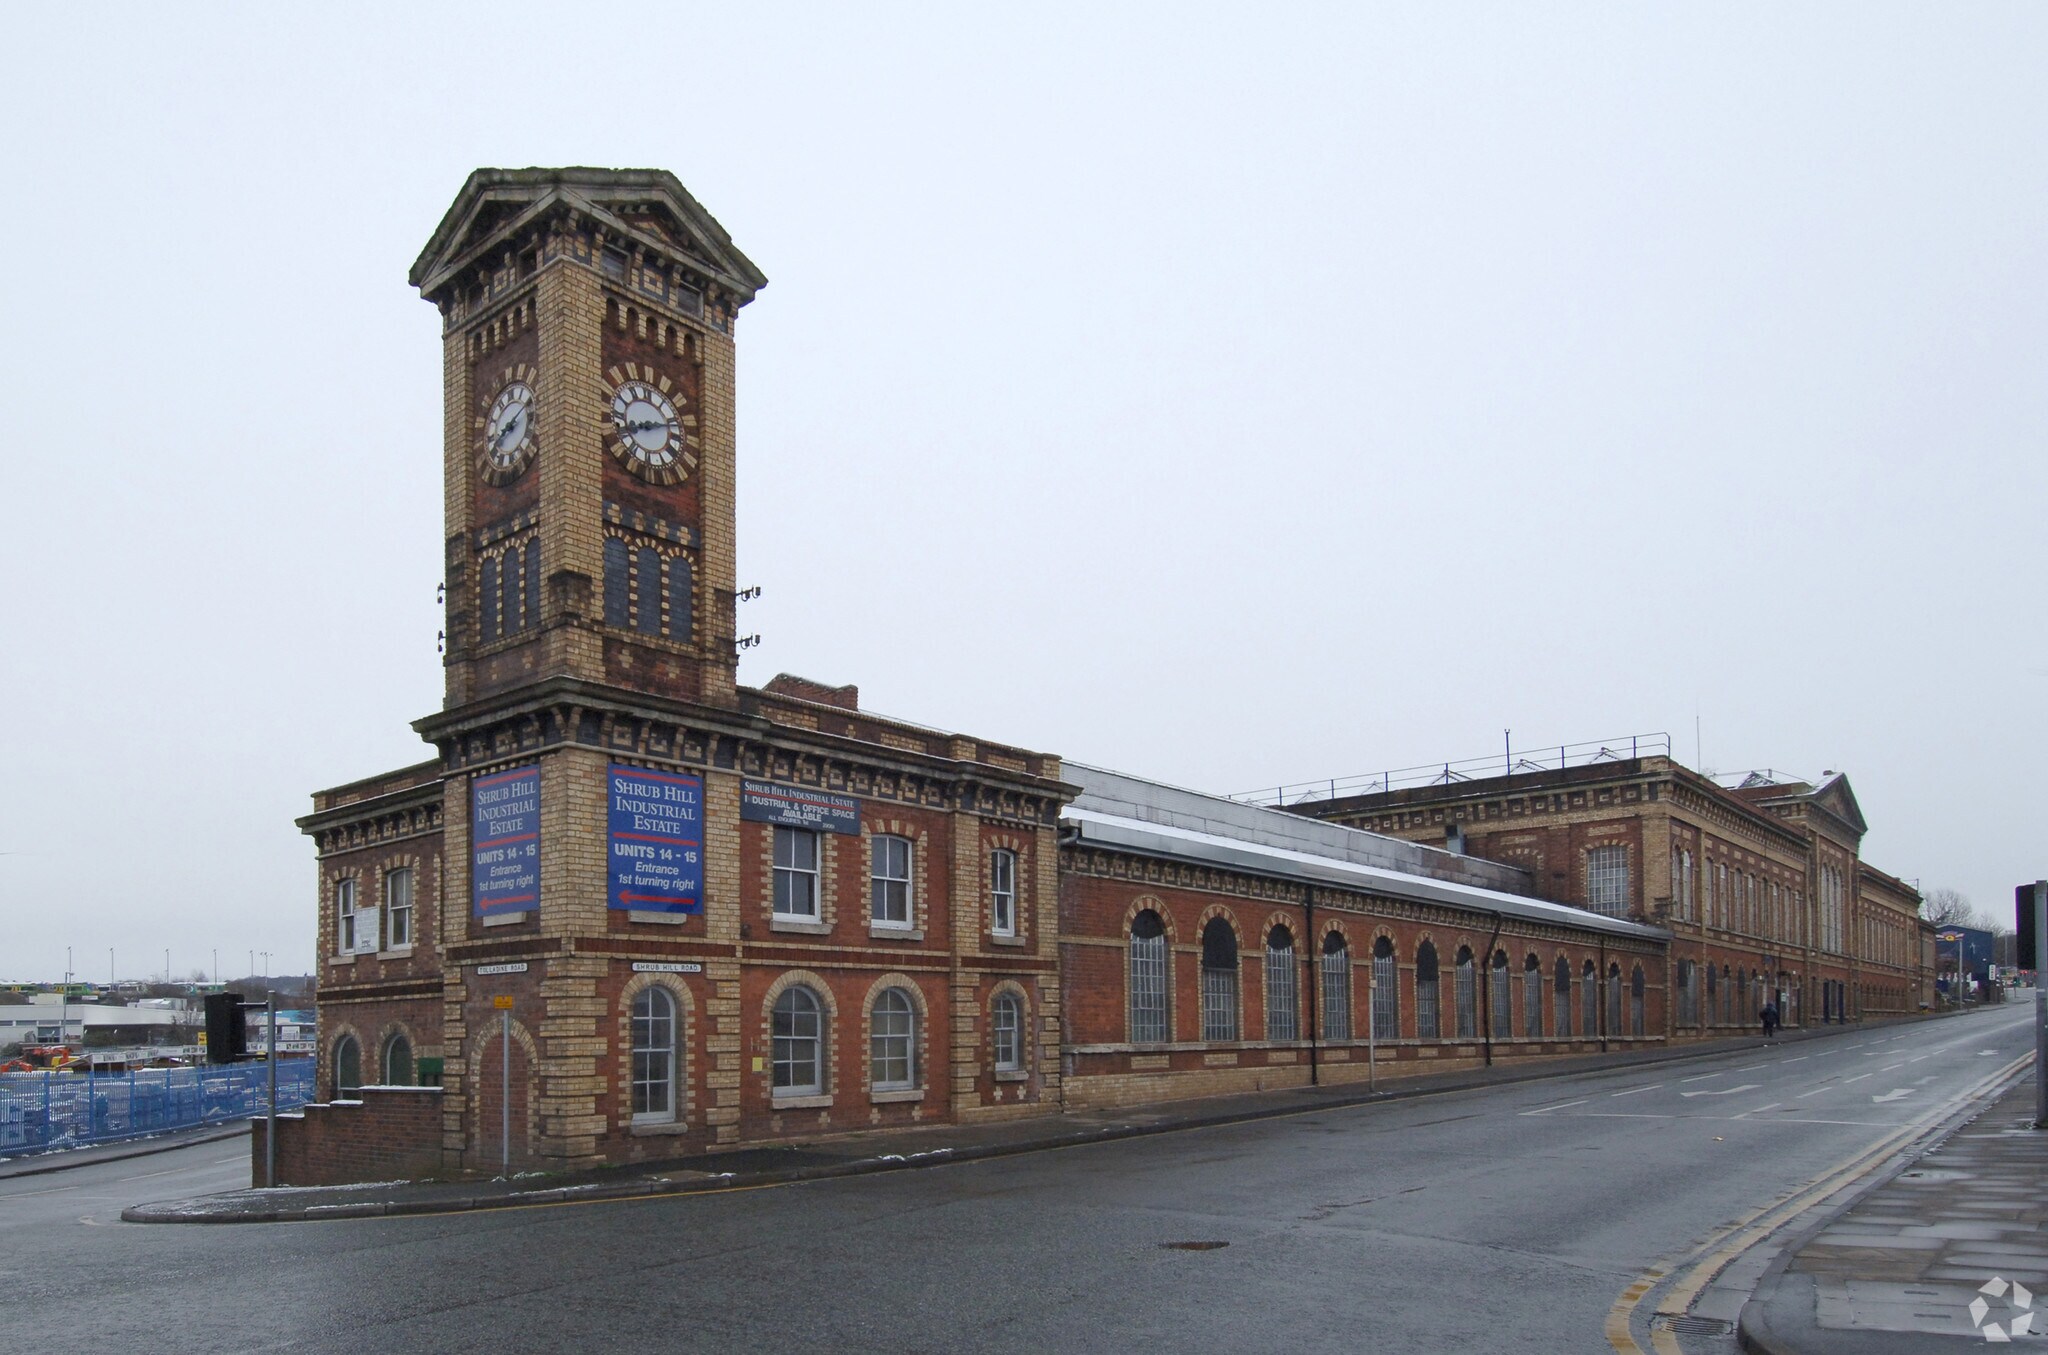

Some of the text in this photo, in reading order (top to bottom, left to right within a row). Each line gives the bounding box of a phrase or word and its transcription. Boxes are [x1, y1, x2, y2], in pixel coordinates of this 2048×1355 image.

[478, 781, 536, 805] SHRUB HILL
[615, 778, 696, 804] SHRUB HILL
[745, 781, 855, 808] SHRUB HILL INDUSTRIAL ESTATE
[478, 799, 536, 822] INDUSTRIAL
[615, 796, 695, 820] INDUSTRIAL
[783, 808, 821, 822] AVAILABLE
[794, 802, 799, 811] &
[802, 804, 829, 815] OFFICE
[832, 808, 855, 819] SPACE
[489, 818, 523, 836] ESTATE
[633, 815, 681, 834] ESTATE
[477, 849, 504, 865] UNITS
[507, 847, 517, 859] 14
[526, 844, 536, 857] 15
[614, 843, 655, 859] UNITS
[659, 849, 673, 861] 14
[684, 851, 697, 863] 15
[490, 863, 522, 877] Entrance
[635, 861, 680, 876] Entrance
[479, 874, 534, 891] 1st turning right
[618, 873, 695, 891] 1st turning right
